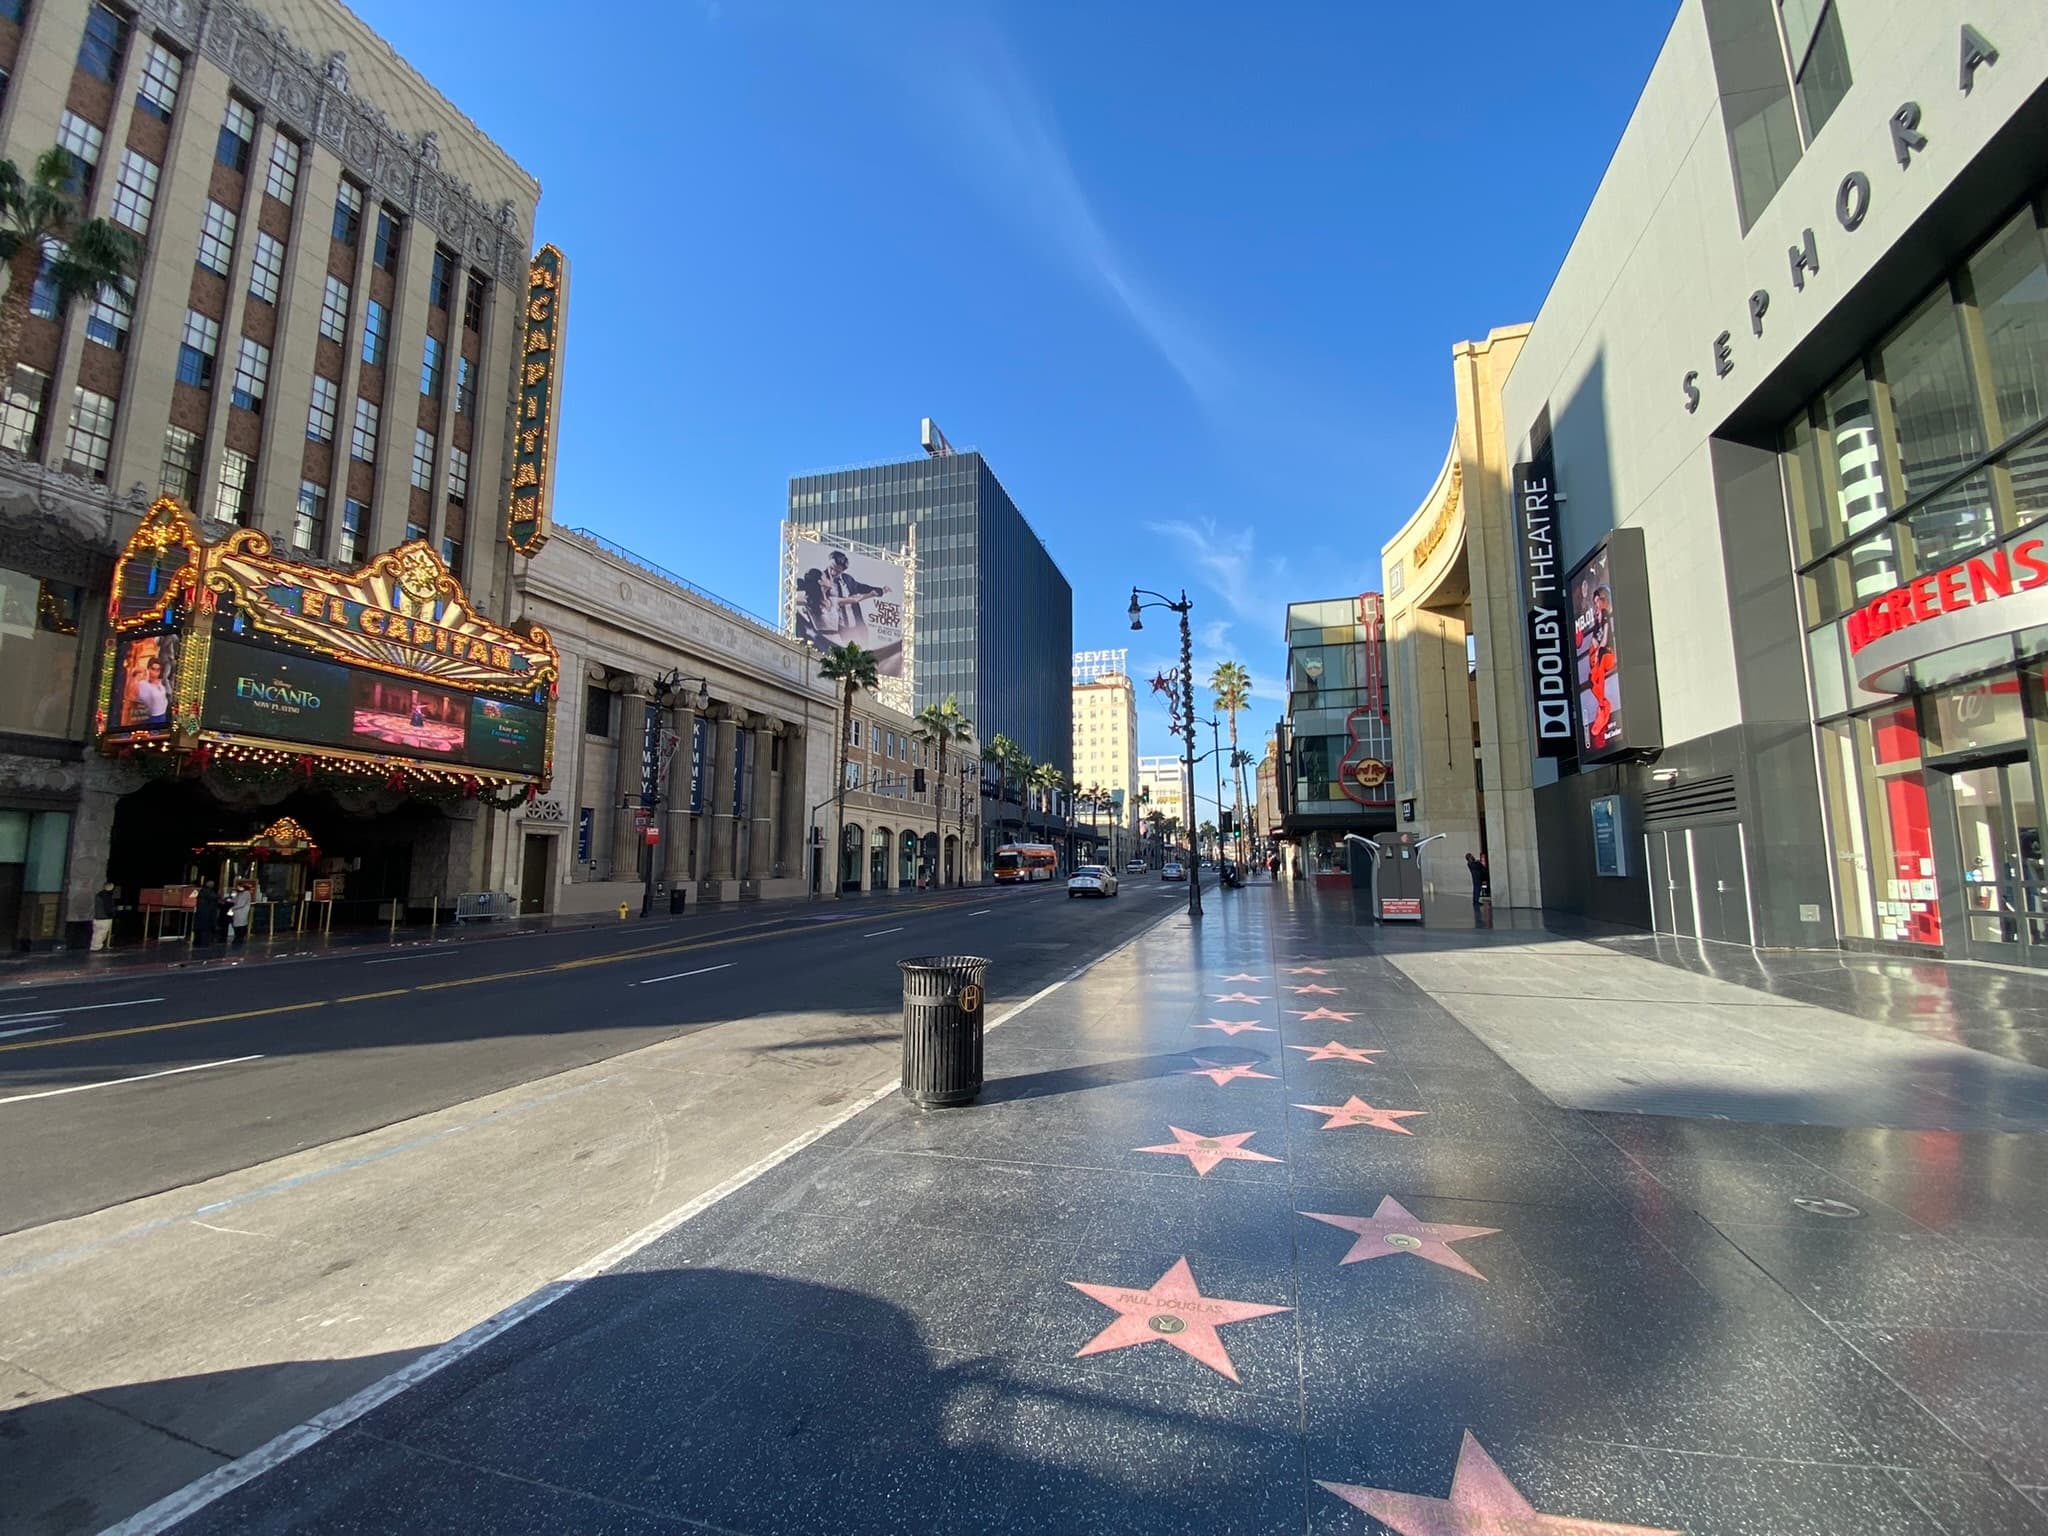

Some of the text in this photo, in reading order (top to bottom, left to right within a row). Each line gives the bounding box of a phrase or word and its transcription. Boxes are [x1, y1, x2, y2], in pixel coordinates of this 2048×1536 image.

[1682, 23, 2000, 414] SEPHORA
[529, 265, 555, 290] EL
[513, 294, 552, 523] CAPITAN
[1523, 477, 1564, 696] DOLBY THEATRE
[868, 613, 901, 629] STORY
[873, 599, 901, 614] WEST
[878, 608, 900, 621] SIDE
[300, 588, 512, 671] EL CAPITAN
[1071, 648, 1129, 664] SEVELT
[236, 676, 321, 709] ENCANTO
[641, 717, 652, 794] JIMMY
[689, 723, 700, 806] KIMMEL
[1116, 1294, 1223, 1314] PAUL DOUGLAS
